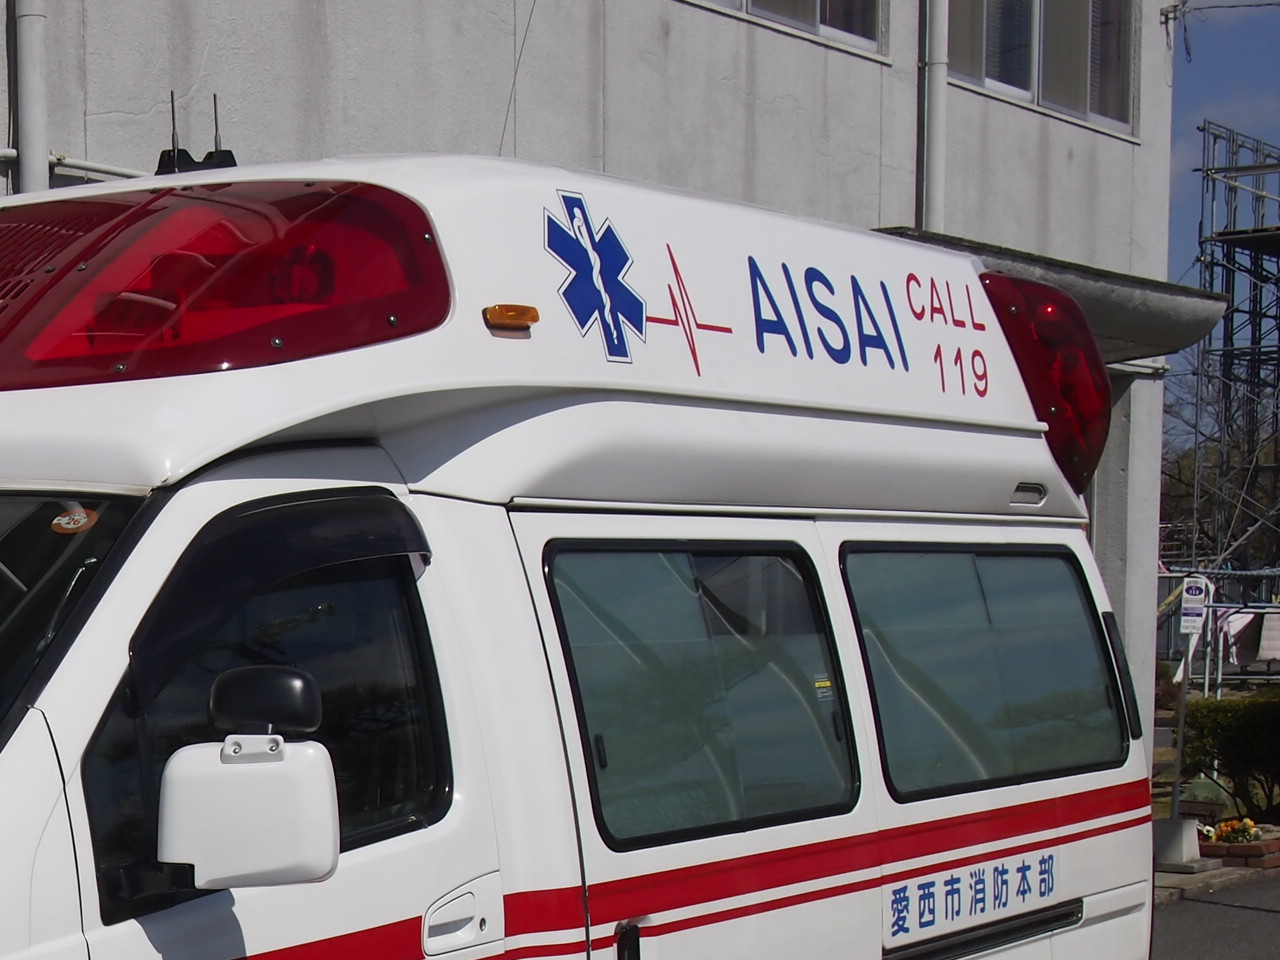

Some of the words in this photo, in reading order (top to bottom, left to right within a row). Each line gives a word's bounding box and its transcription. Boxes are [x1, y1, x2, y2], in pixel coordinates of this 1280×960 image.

[748, 255, 909, 372] AISAI
[905, 272, 986, 331] CALL
[933, 343, 988, 398] 119
[891, 854, 1054, 937] 愛西市消防本部
